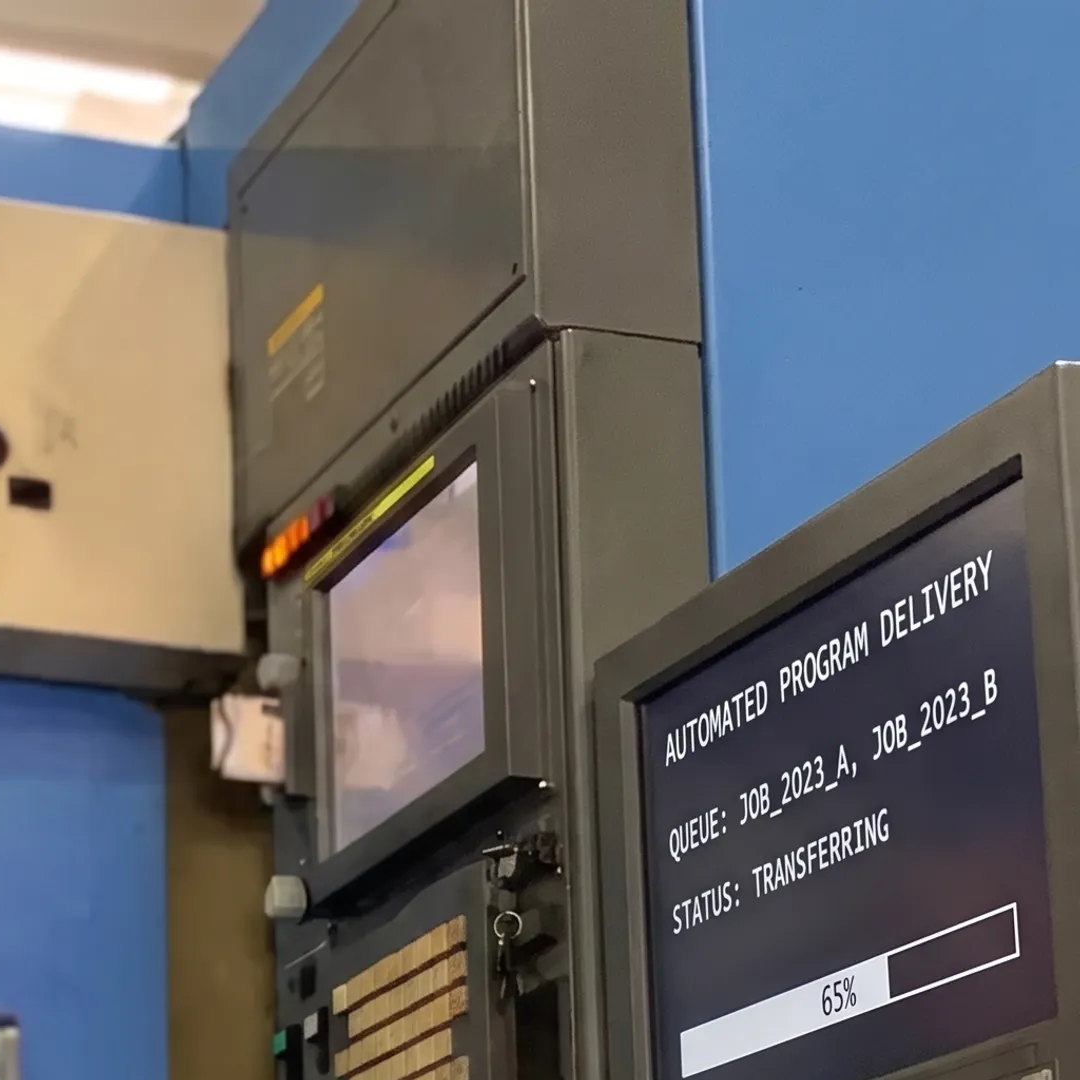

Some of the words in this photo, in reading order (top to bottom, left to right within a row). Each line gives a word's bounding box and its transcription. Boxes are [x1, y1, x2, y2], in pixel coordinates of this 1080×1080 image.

[665, 680, 768, 767] AUTOMATED
[779, 621, 869, 703] PROGRAM
[879, 549, 993, 648] DELIVERY
[669, 807, 727, 863] QUEUE:
[739, 744, 858, 826] JOB_2023_A,
[872, 668, 998, 761] JOB_2023_B
[672, 881, 740, 935] STATUS:
[751, 807, 890, 898] TRANSFERRING
[821, 975, 857, 1016] 65%
